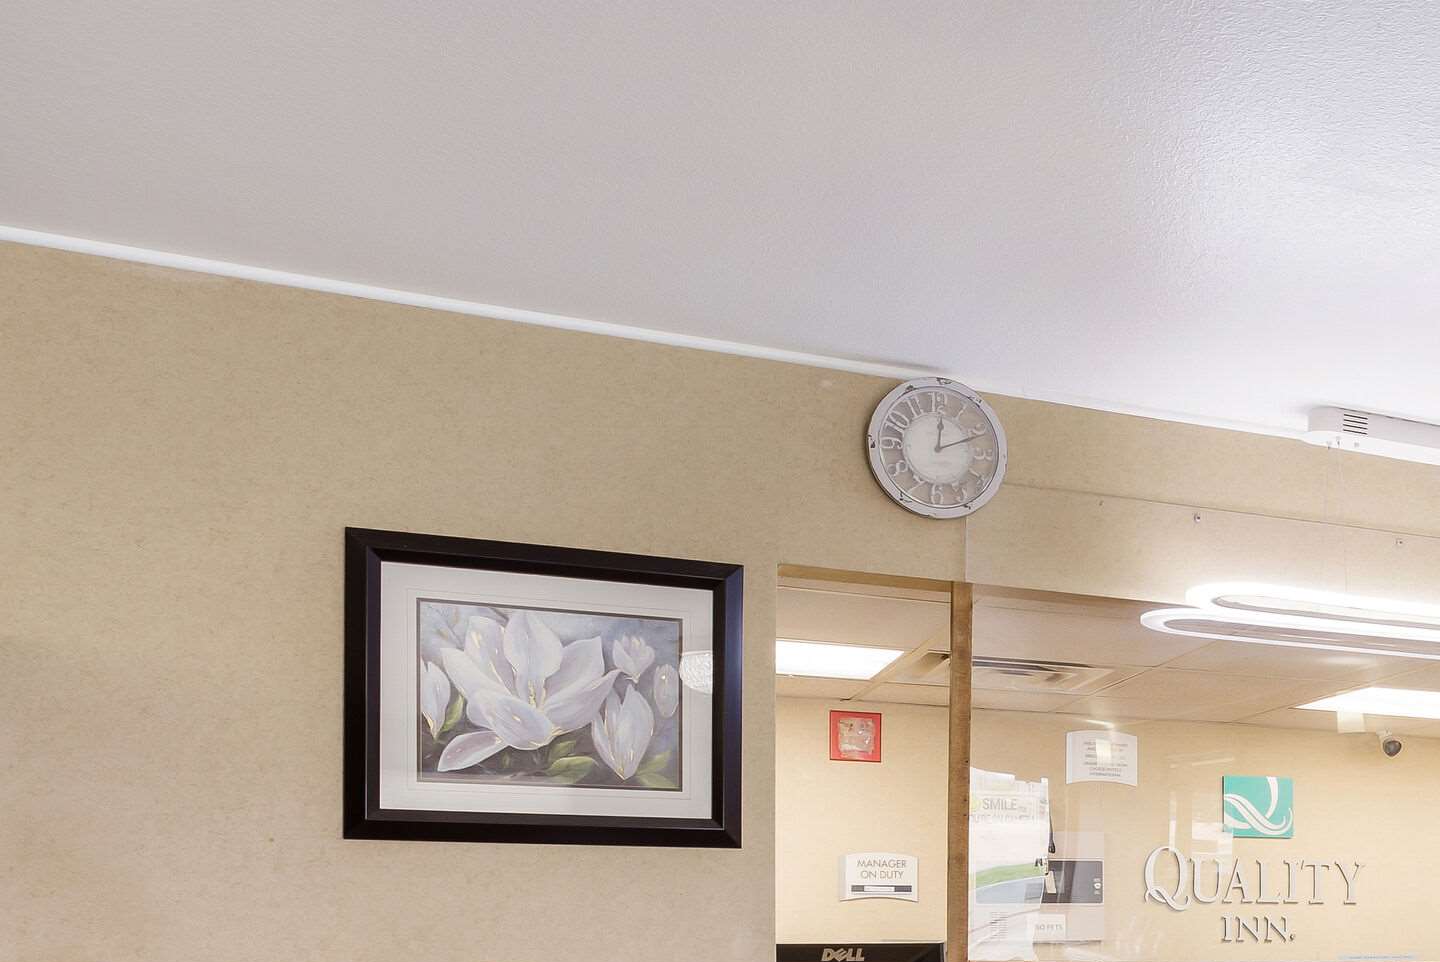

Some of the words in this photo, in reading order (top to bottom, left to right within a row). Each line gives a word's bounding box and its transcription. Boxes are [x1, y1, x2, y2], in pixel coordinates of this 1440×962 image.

[982, 798, 1018, 810] SMILE
[857, 858, 907, 869] MANAGER
[861, 870, 878, 880] ON
[880, 870, 905, 881] DUTY
[1144, 846, 1365, 911] QUALITY
[820, 948, 865, 962] DELL
